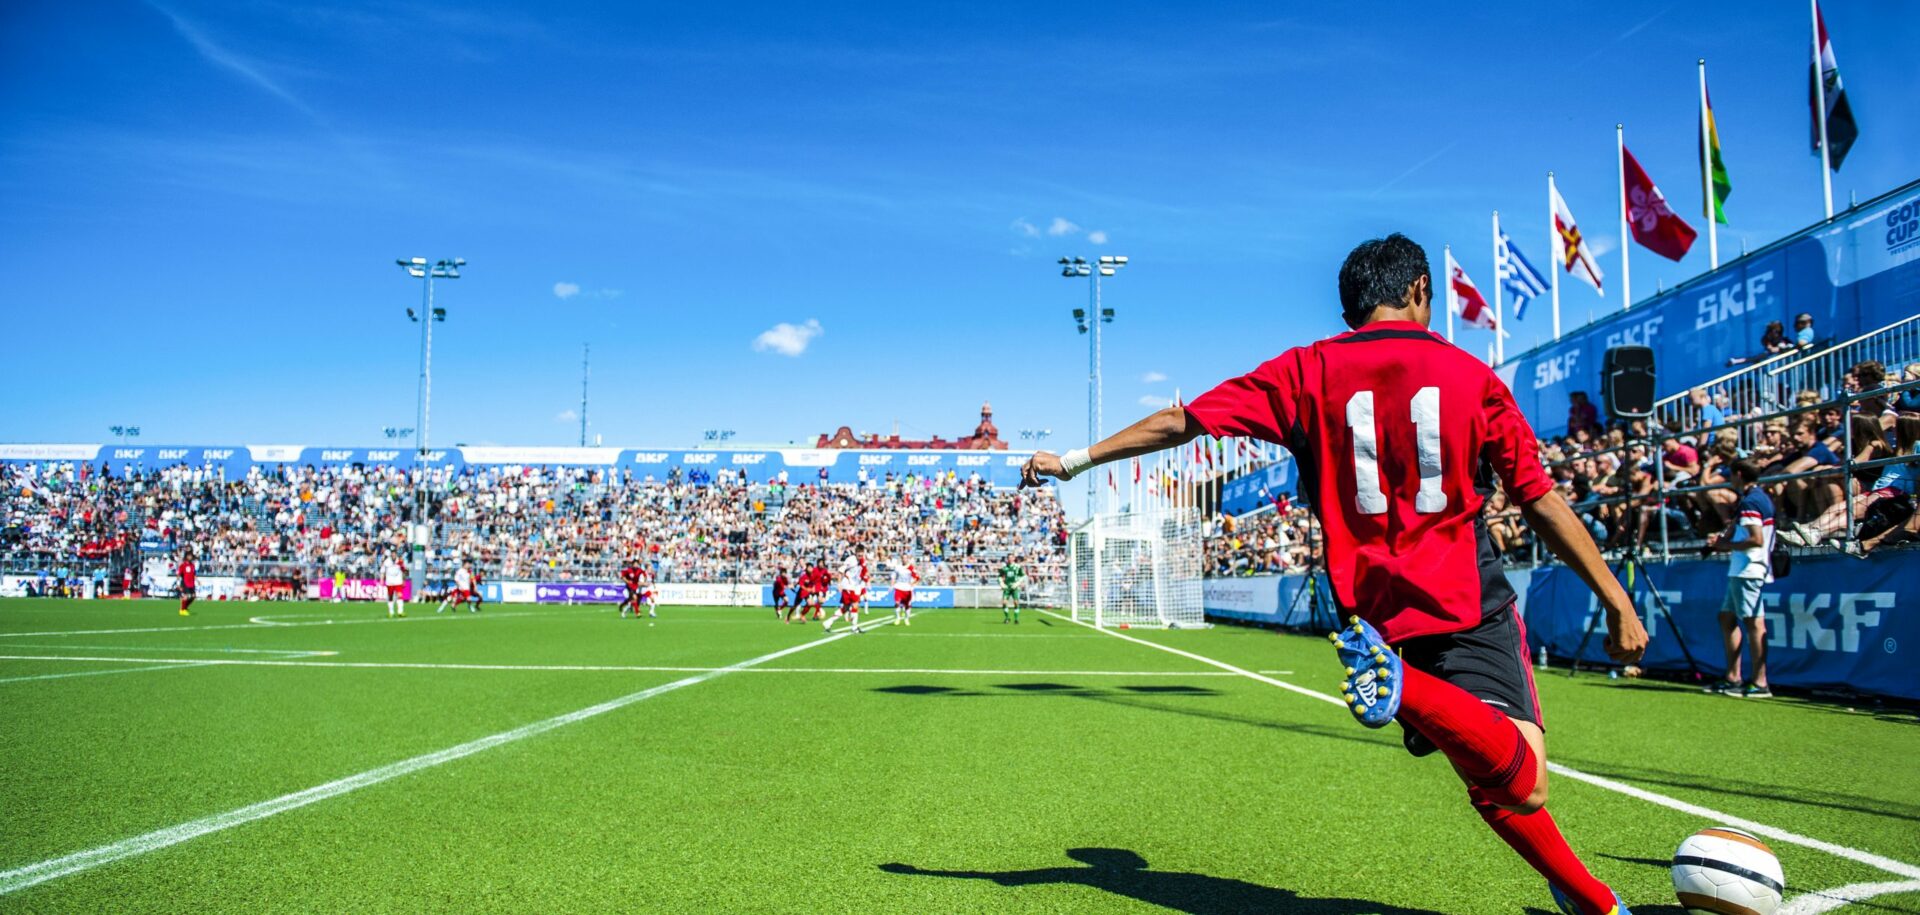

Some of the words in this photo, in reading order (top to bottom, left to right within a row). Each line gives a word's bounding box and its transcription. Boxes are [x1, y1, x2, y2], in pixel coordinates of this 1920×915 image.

[1886, 220, 1919, 246] CUP
[1695, 271, 1774, 331] SKF
[1534, 349, 1580, 390] SKF
[114, 448, 146, 459] SKF
[158, 449, 190, 460] SKF
[203, 449, 234, 460] SKF
[322, 450, 354, 460] SKF
[368, 450, 400, 460] SKF
[1346, 386, 1448, 514] 11
[635, 452, 669, 463] SKF
[684, 453, 718, 464] SKF
[732, 454, 766, 464] SKF
[859, 454, 893, 465] SKF
[908, 455, 942, 466] SKF
[956, 455, 992, 466] SKF
[1583, 590, 1682, 637] SF
